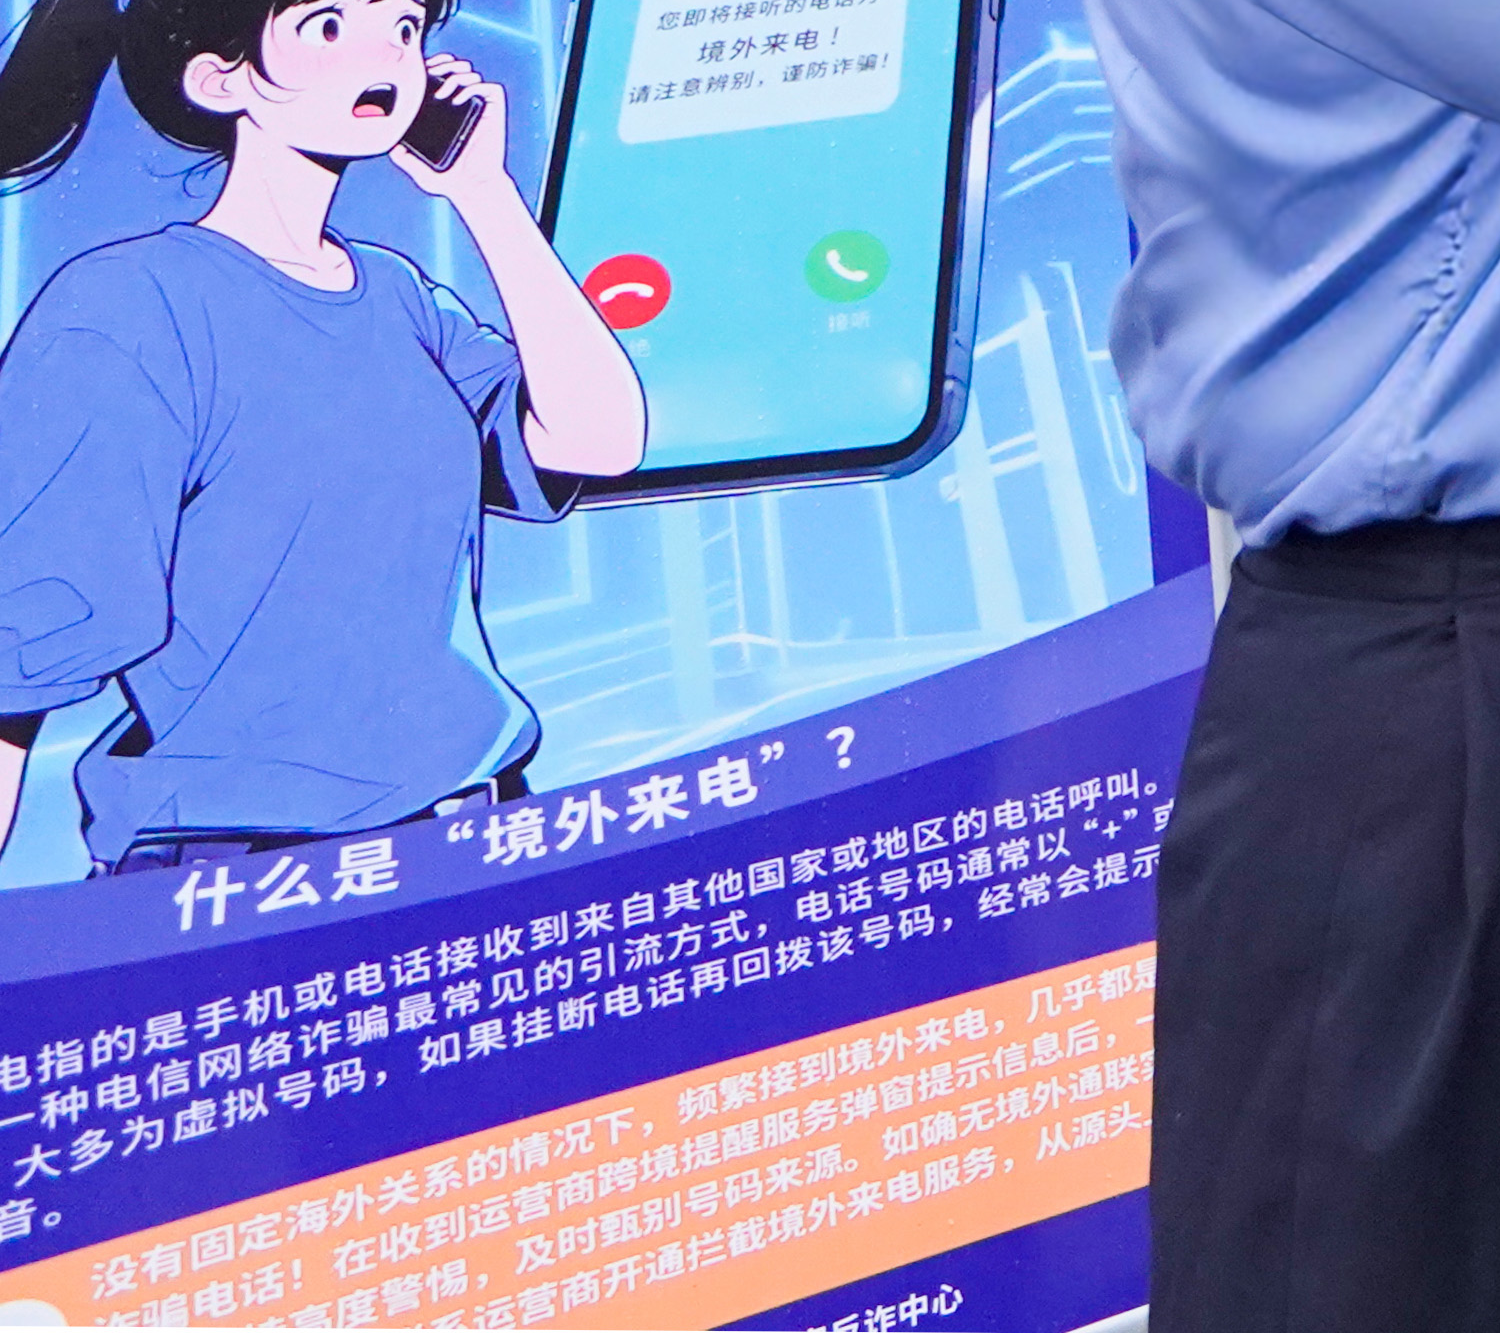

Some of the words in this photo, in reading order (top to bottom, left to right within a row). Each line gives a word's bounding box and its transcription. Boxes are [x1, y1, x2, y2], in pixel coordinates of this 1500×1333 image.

[696, 27, 841, 65] 境外来电！
[173, 724, 857, 932] 什么是“境外来电”？
[246, 1049, 1155, 1329] 高度警惕，及时甄别号码来源。如确无境外通联
[402, 1101, 1153, 1330] 系运营商开通拦截境外来电服务，从源头
[806, 1282, 964, 1332] 反诈中心
